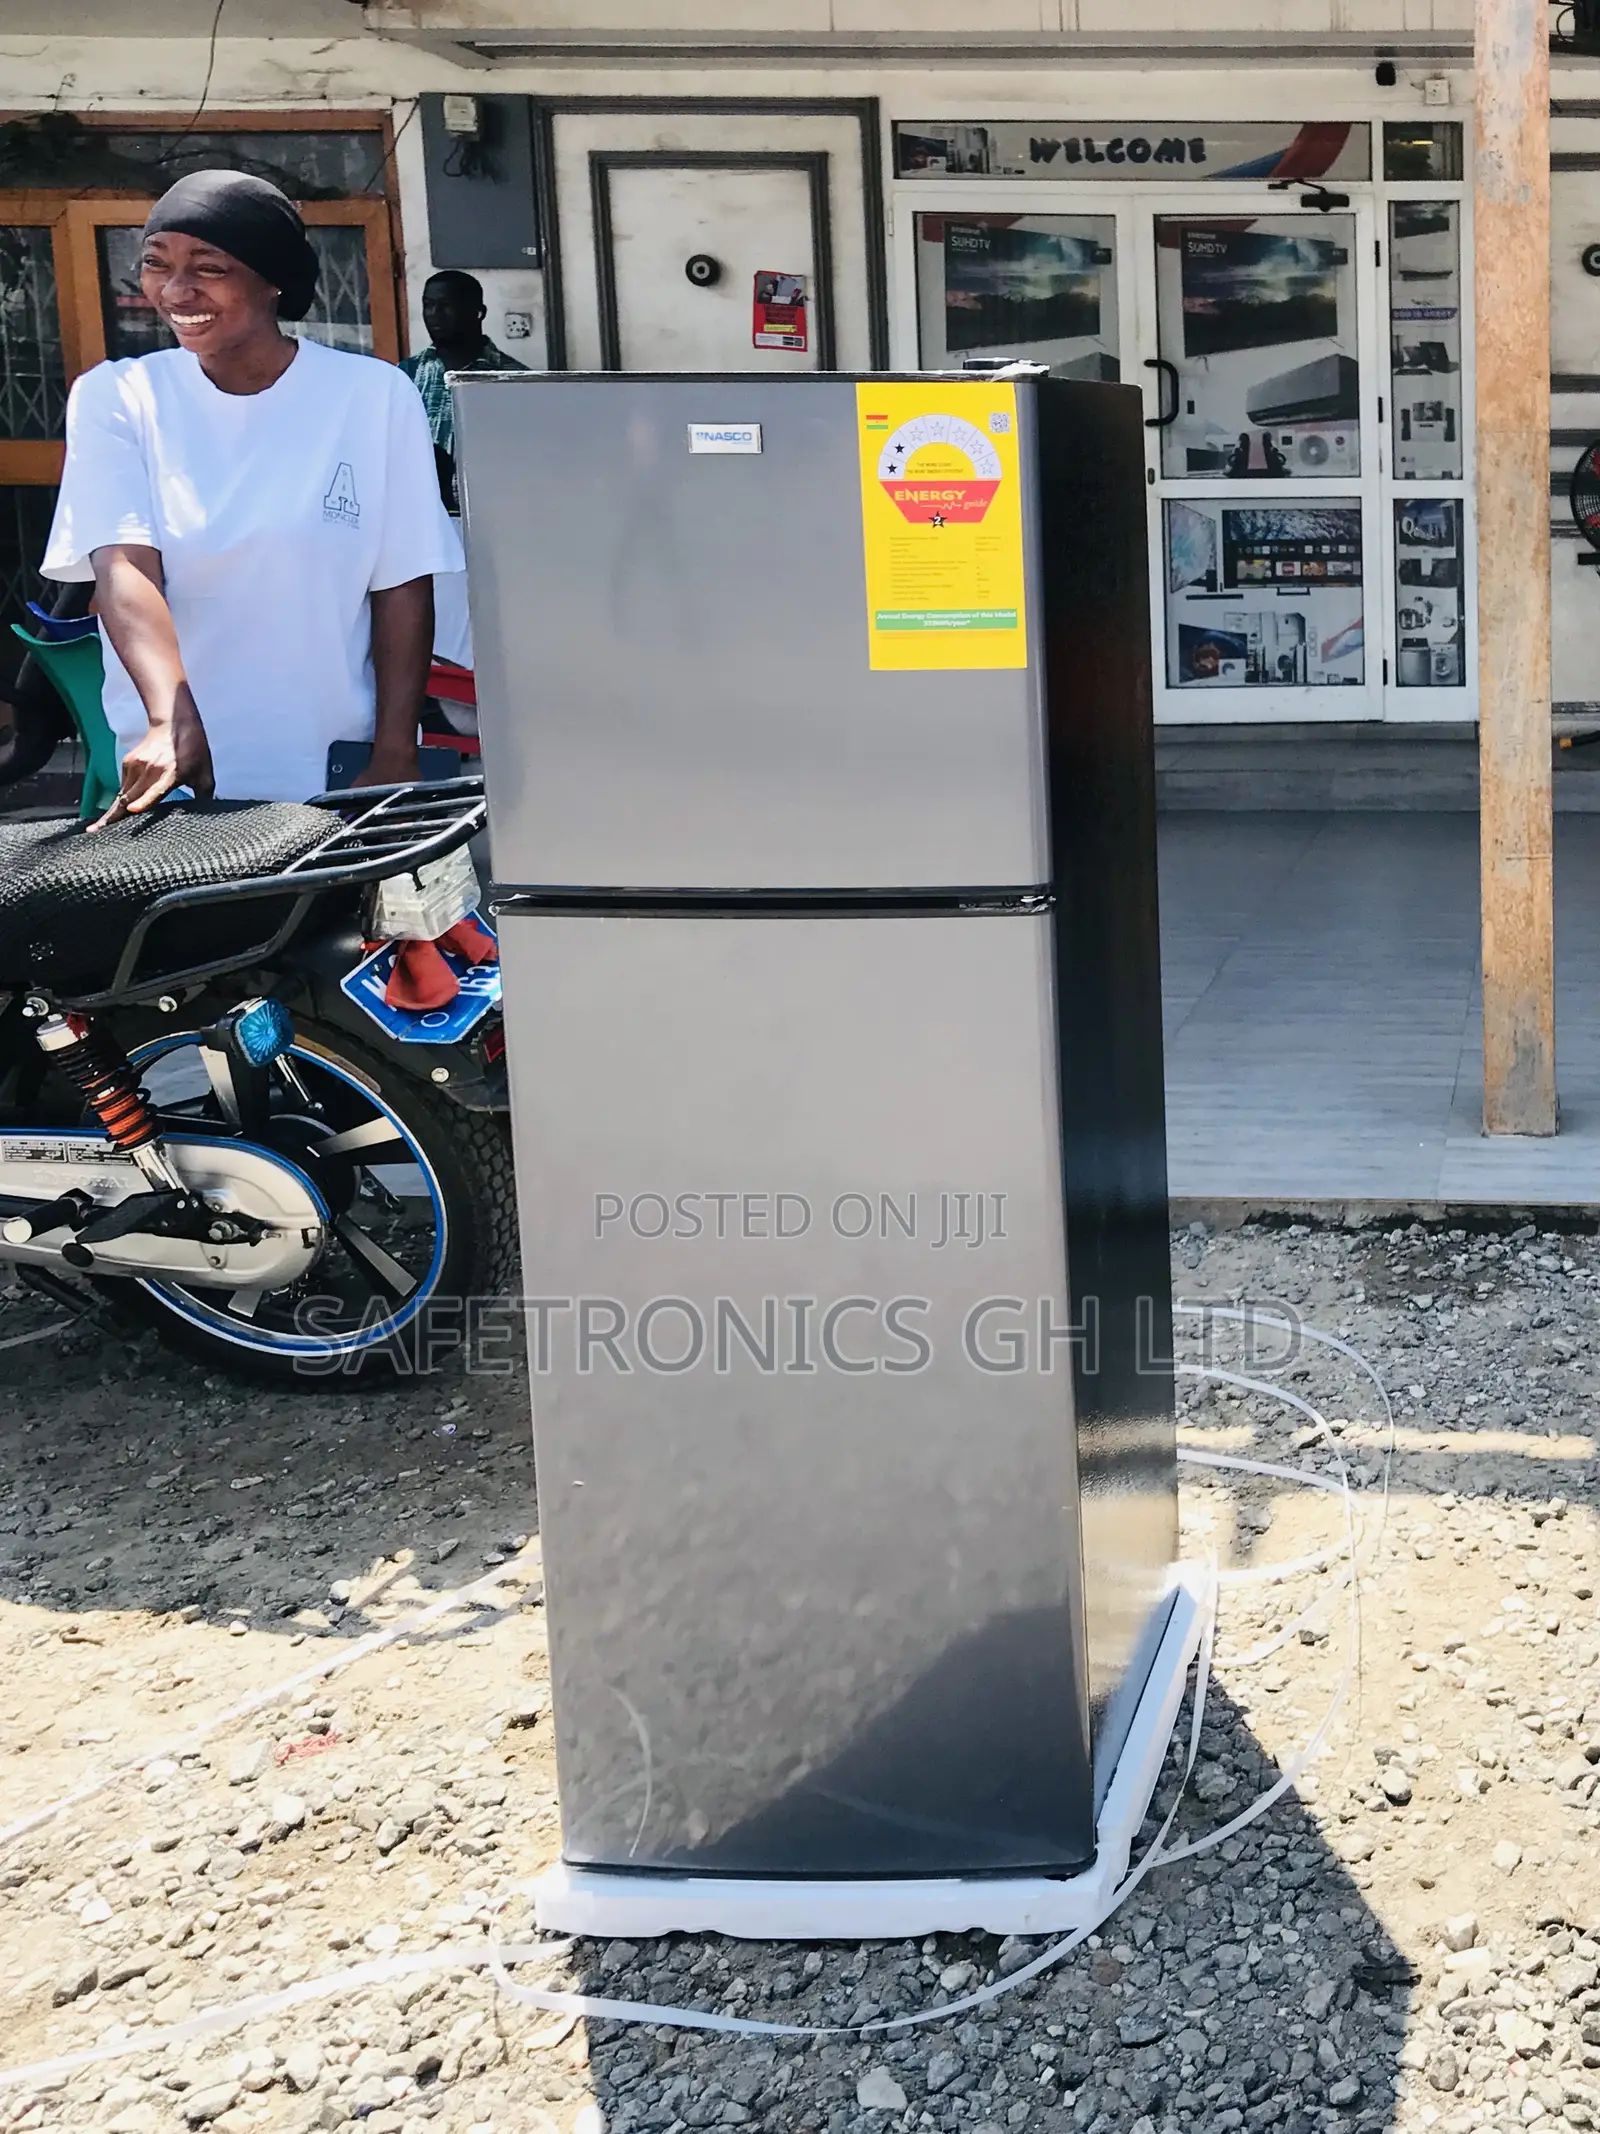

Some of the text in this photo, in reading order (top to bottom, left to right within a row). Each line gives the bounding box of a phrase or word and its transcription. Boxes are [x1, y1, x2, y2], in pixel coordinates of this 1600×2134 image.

[1030, 137, 1207, 164] WELCOME
[704, 432, 752, 441] NASCO
[894, 488, 966, 504] ENERGY
[934, 516, 942, 525] 2
